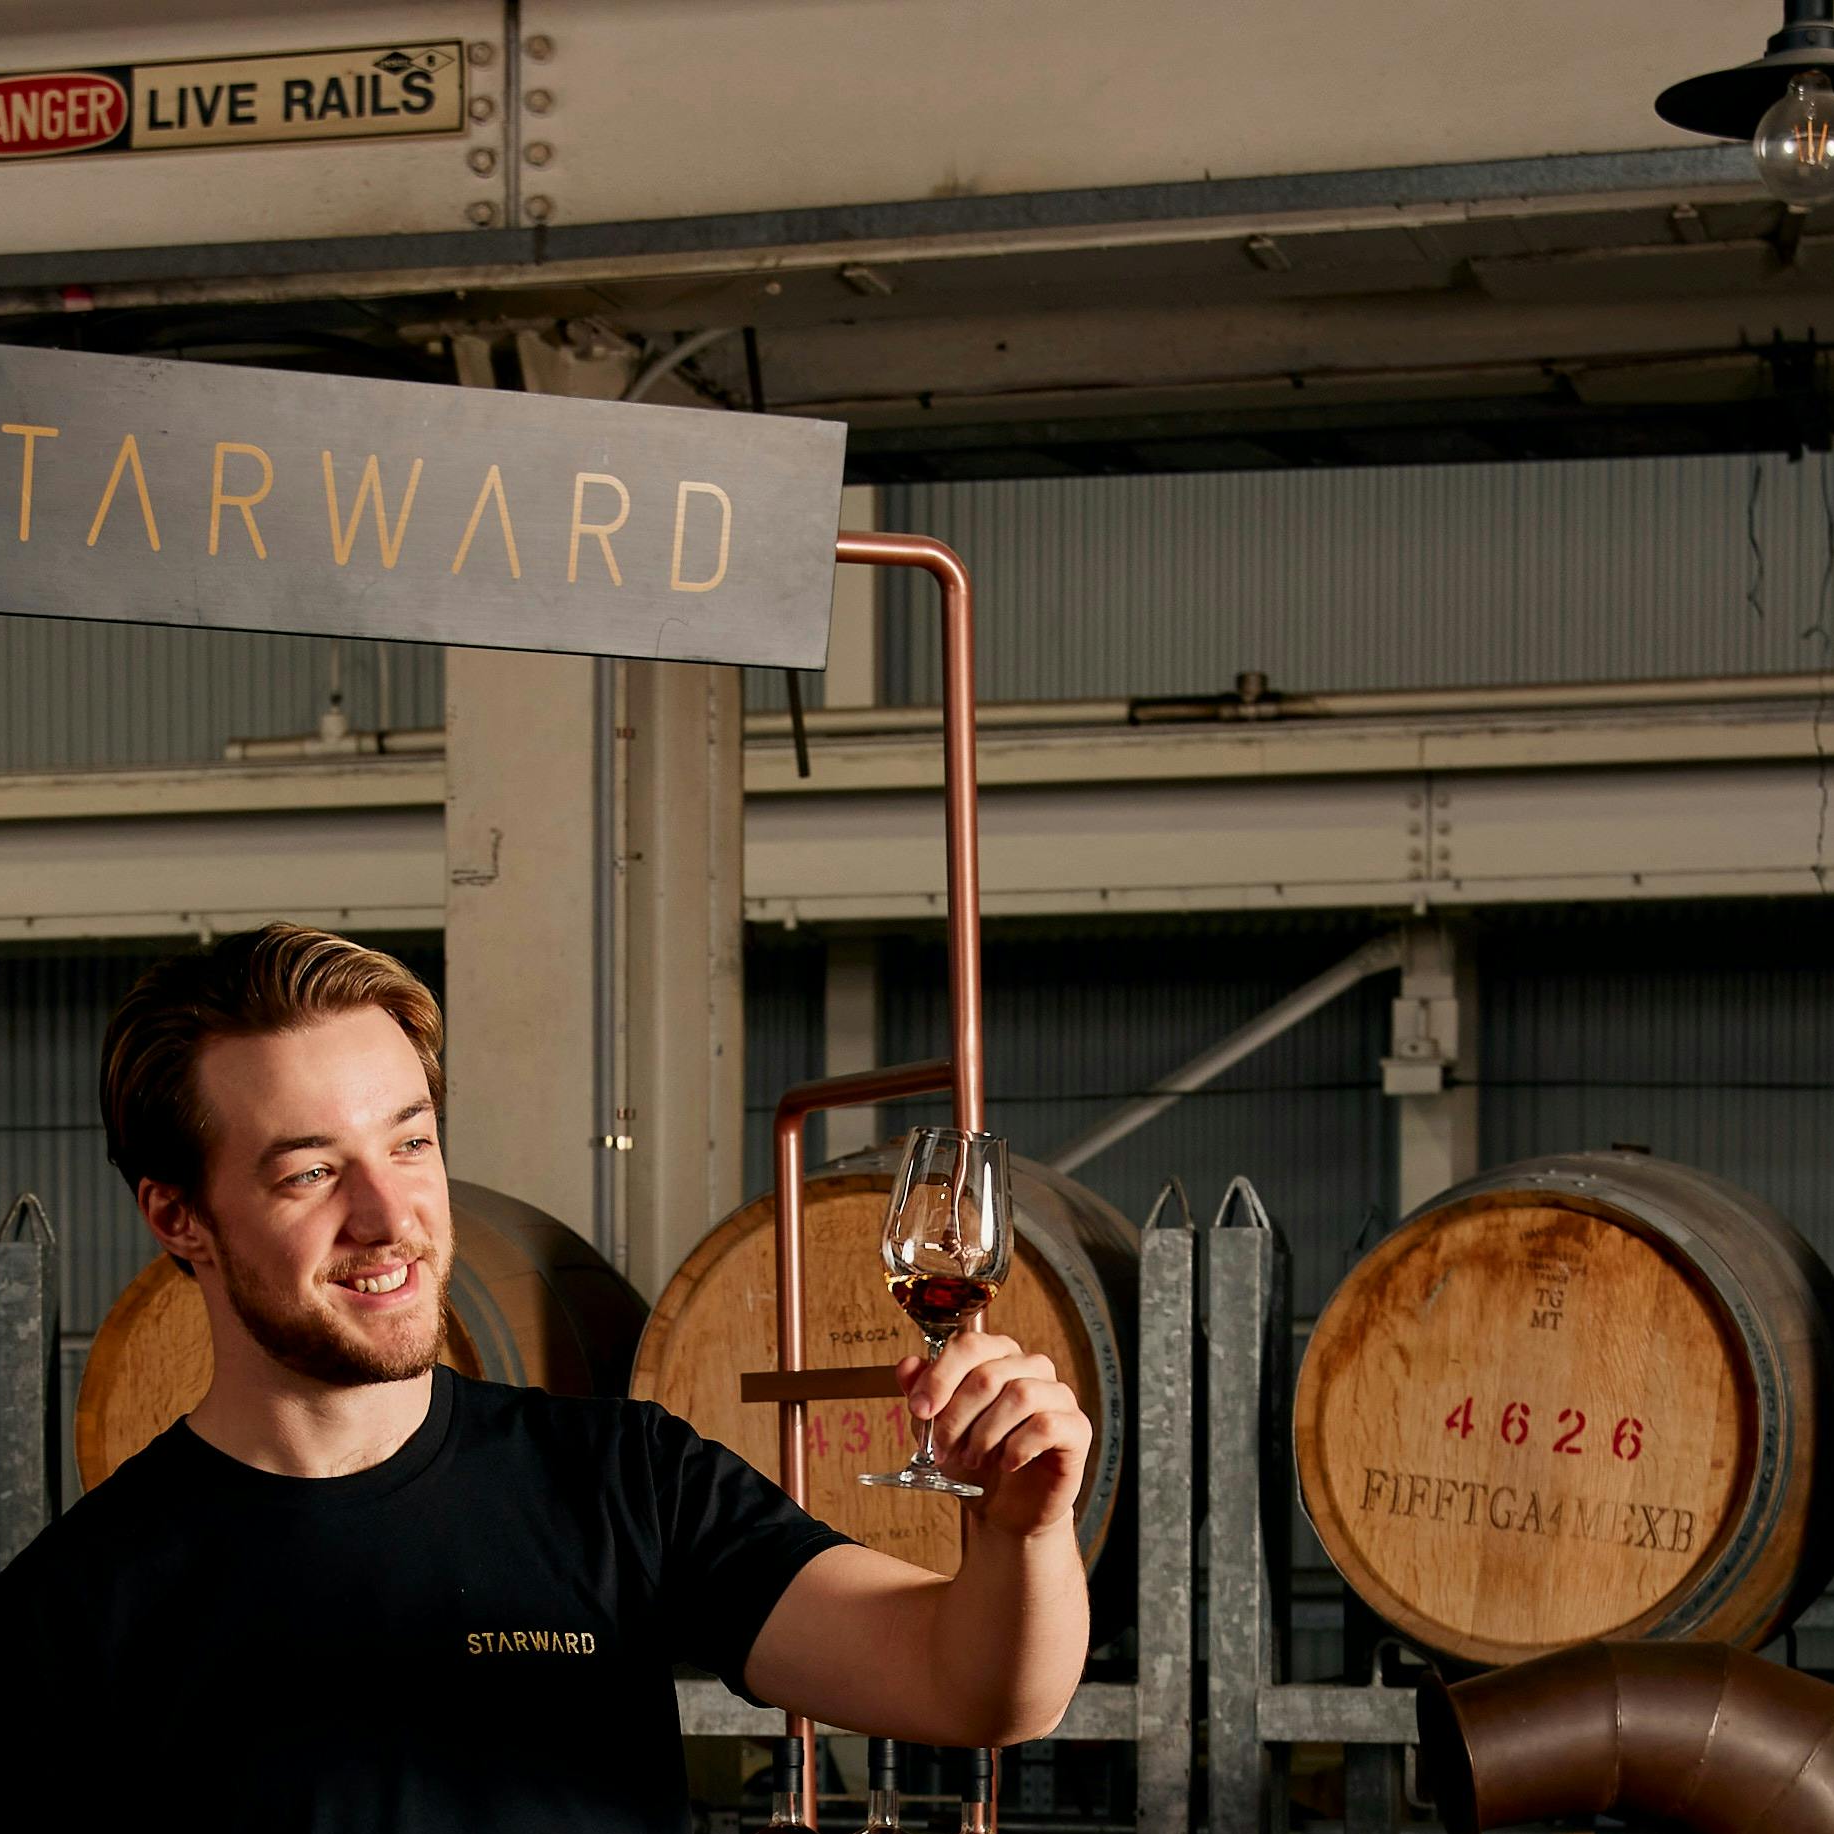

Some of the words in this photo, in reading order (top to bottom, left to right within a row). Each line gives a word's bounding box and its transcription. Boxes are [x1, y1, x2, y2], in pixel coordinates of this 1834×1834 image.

[147, 82, 257, 131] LIVE
[283, 71, 436, 122] RAILS
[1445, 1397, 1644, 1461] 4626
[467, 1631, 596, 1655] STARWARD
